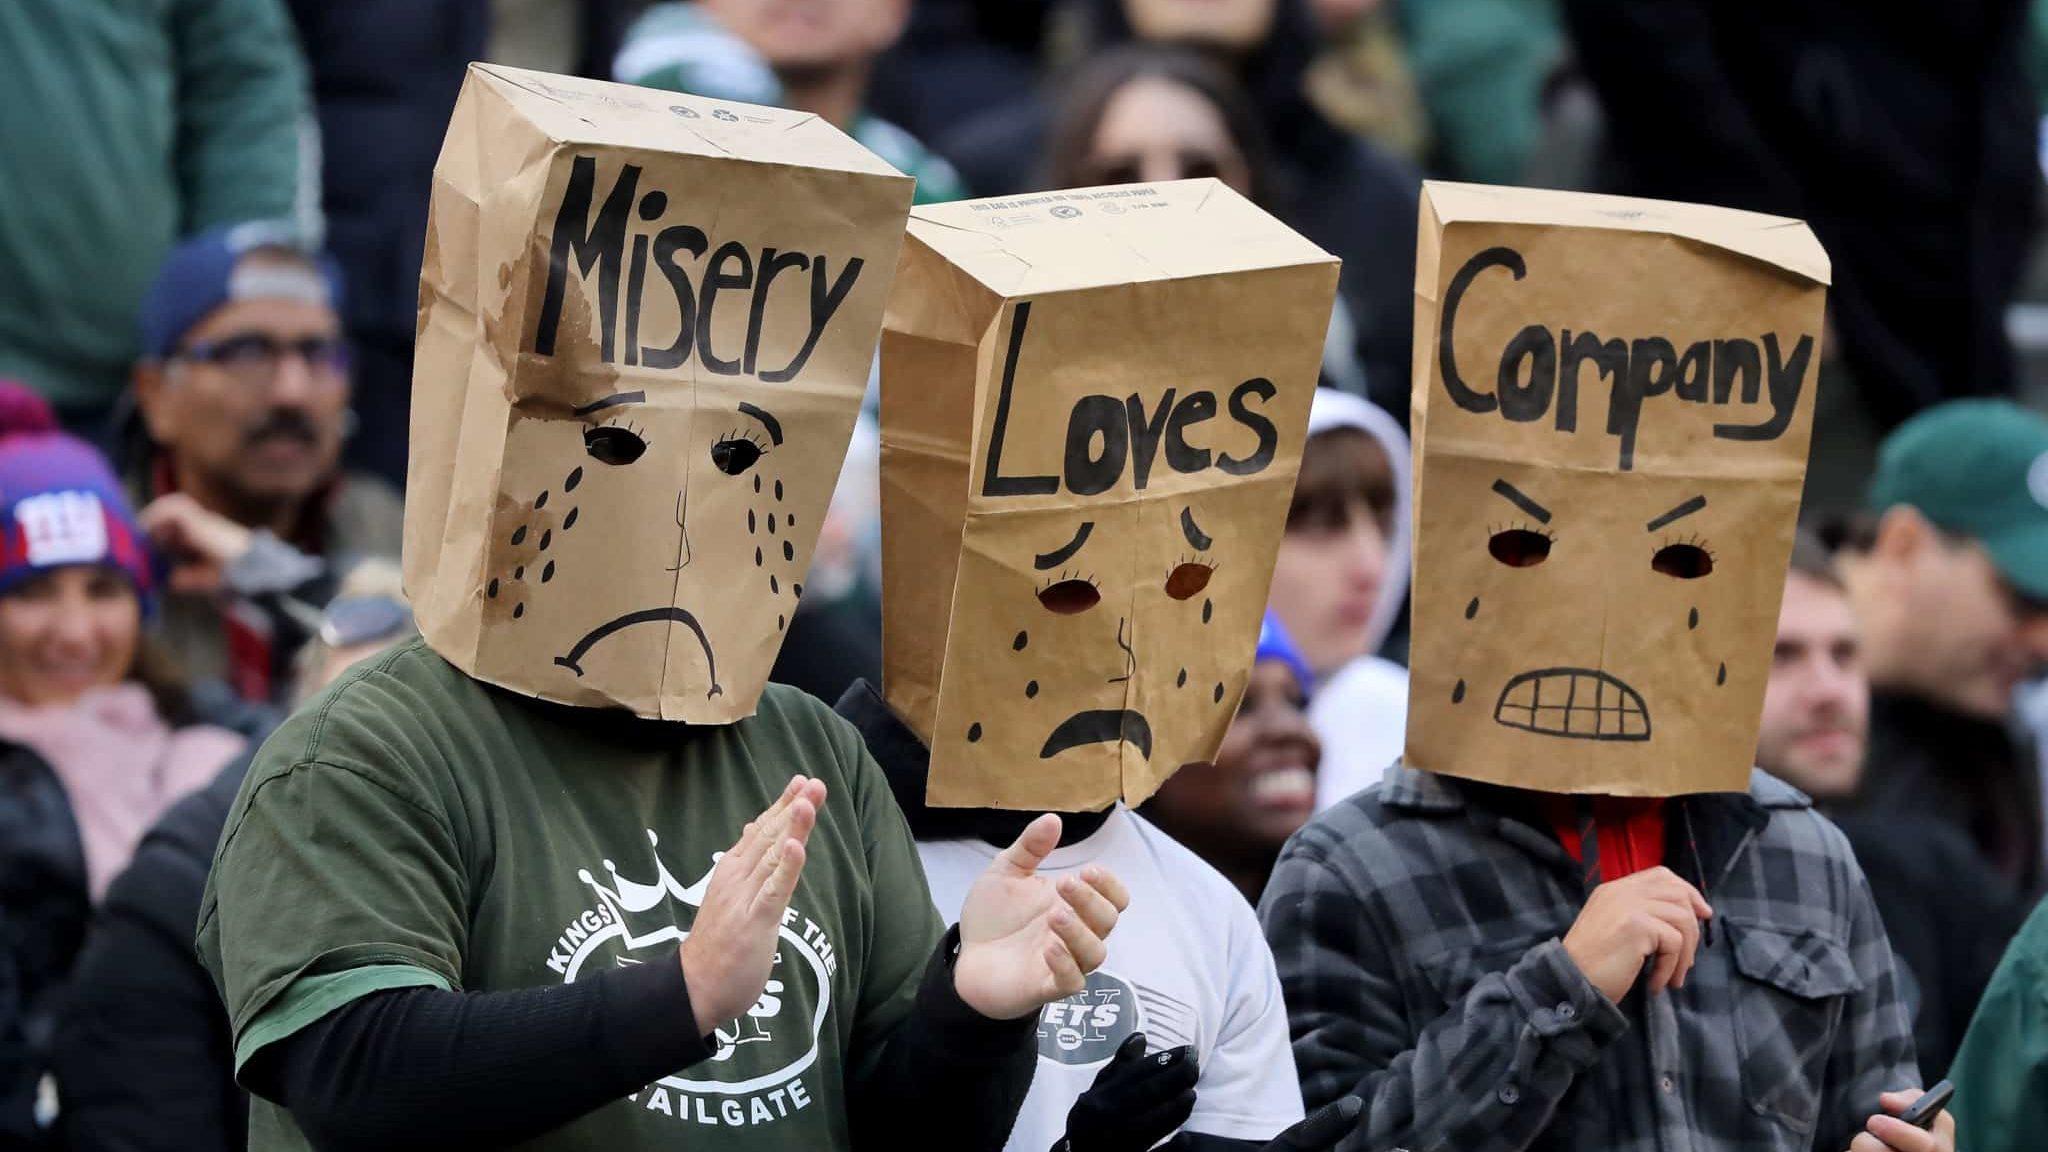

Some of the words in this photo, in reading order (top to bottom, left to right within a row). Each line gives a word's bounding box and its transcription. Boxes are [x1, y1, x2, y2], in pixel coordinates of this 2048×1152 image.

[535, 154, 864, 382] Misery
[982, 300, 1278, 497] Loves
[1439, 246, 1814, 471] Company
[546, 903, 612, 975] KINGS
[803, 917, 837, 977] THE
[1043, 1002, 1121, 1028] ETS
[627, 1079, 812, 1126] AILGATE
